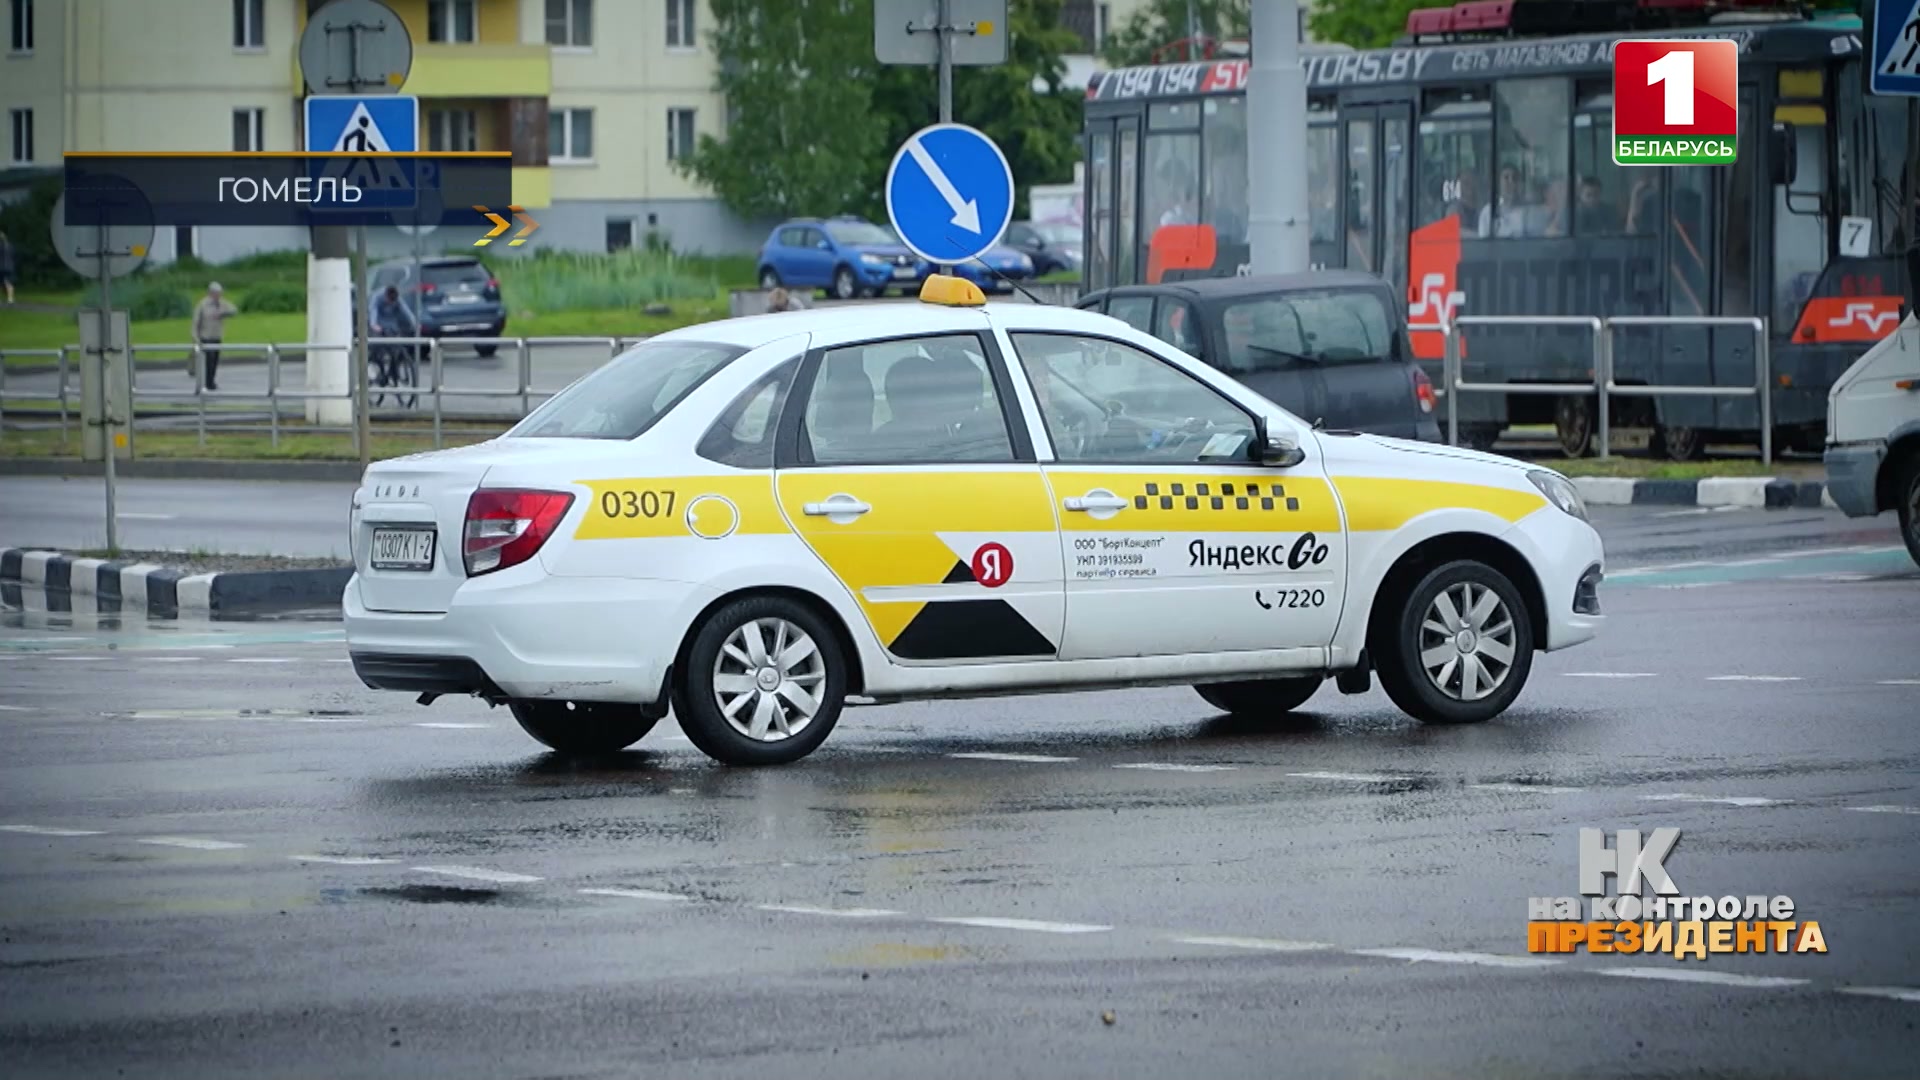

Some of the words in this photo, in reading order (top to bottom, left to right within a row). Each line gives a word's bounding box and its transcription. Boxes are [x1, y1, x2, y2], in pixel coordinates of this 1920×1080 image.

[1442, 179, 1462, 201] 614
[1847, 222, 1865, 248] 7
[375, 485, 419, 498] LADA
[601, 490, 676, 518] 0307
[1074, 539, 1096, 550] ООО
[1188, 539, 1284, 570] Яндекс
[1287, 532, 1329, 570] Go
[981, 549, 1001, 581] Я
[1076, 554, 1096, 566] УНП
[1277, 589, 1325, 608] 7220
